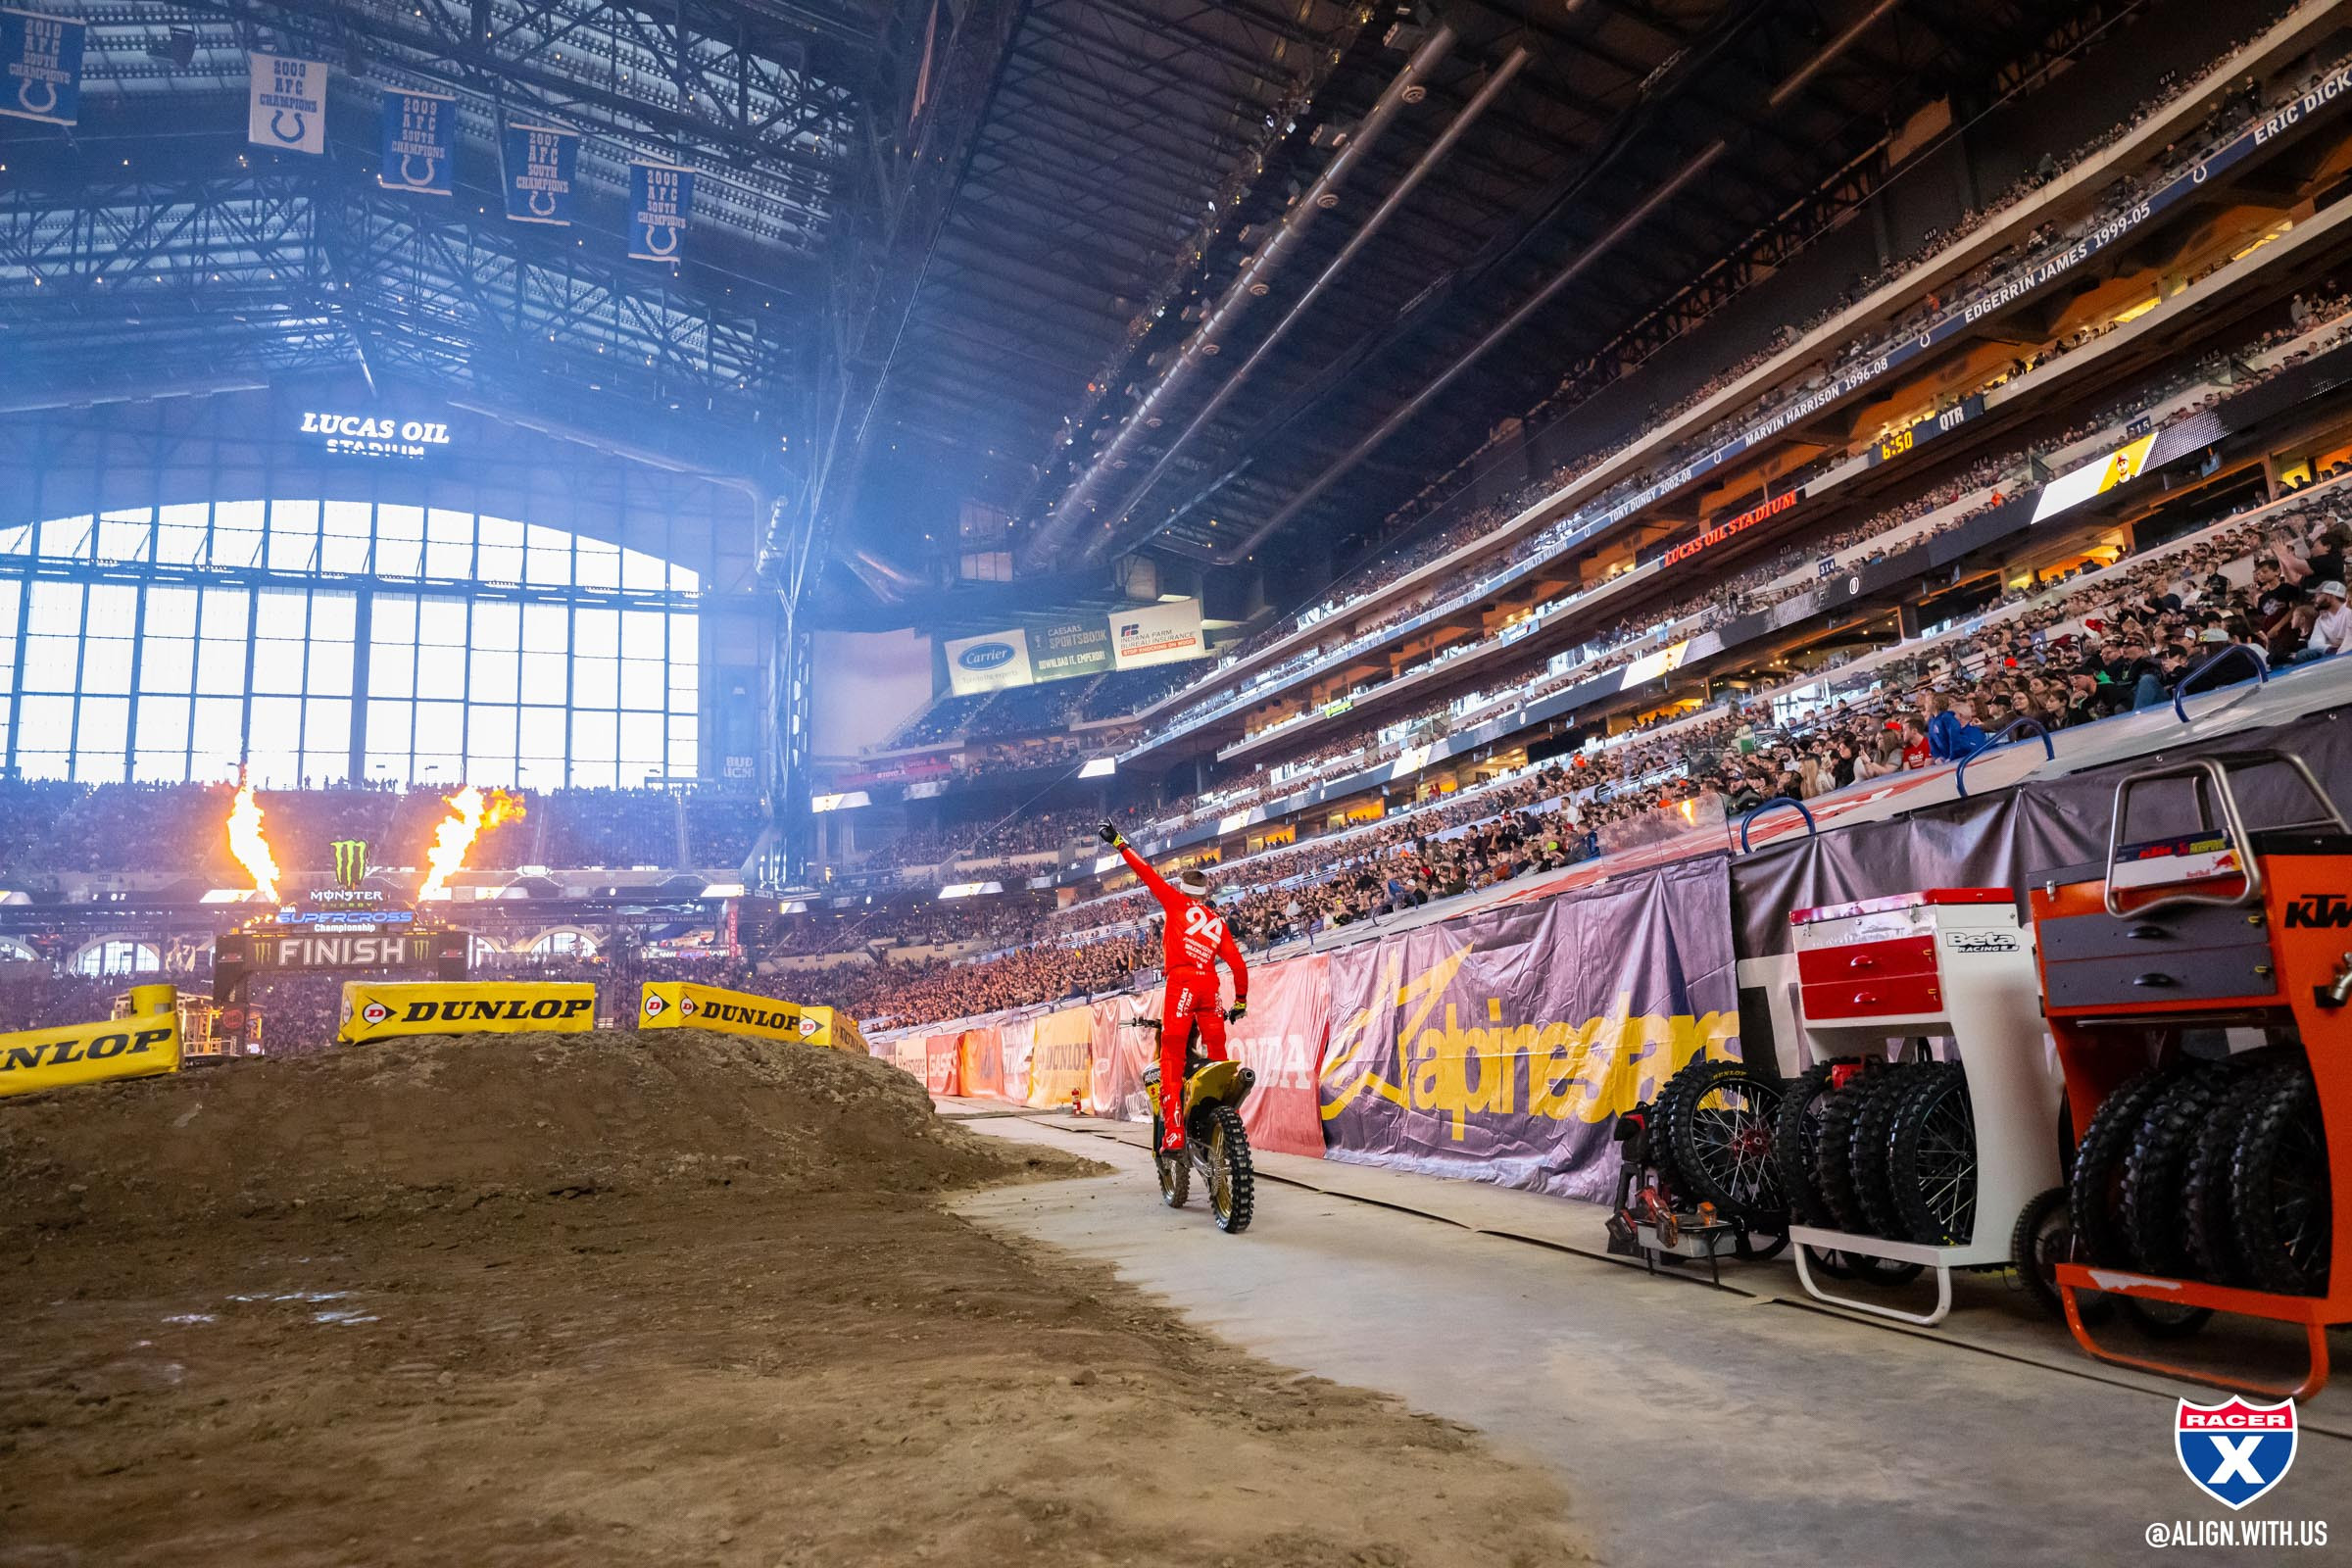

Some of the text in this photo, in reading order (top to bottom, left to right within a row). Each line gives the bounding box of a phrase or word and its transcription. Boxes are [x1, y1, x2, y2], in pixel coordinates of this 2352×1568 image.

[24, 51, 58, 67] SOUTH
[9, 63, 71, 85] CHAMPIONS
[260, 93, 317, 113] CHAMPIONS
[2254, 106, 2299, 146] ERIC
[403, 129, 434, 144] SOUTH
[529, 132, 560, 146] 2007
[392, 140, 445, 159] CHAMPIONS
[528, 145, 558, 165] AFC
[528, 164, 558, 178] SOUTH
[515, 175, 568, 193] CHAMPIONS
[648, 186, 677, 202] AFC
[648, 201, 676, 213] SOUTH
[638, 212, 686, 228] CHAMPIONS
[1965, 202, 2150, 323] EDGERRIN JAMES 1999-05
[1745, 358, 1888, 447] MARVIN HARRISON 1996-08
[300, 412, 451, 444] LUCAS OIL
[1882, 406, 1964, 460] 6:50 QTR
[2130, 419, 2150, 434] 15
[326, 438, 424, 460] STADIUM
[1608, 469, 1691, 523] TONY DUNGY 2002-08
[1664, 490, 1796, 567] LUCAS OIL STADIUM
[1523, 540, 1567, 571] COLTS NATION
[1820, 562, 1835, 574] 314
[1048, 624, 1082, 637] CAESARS
[1050, 629, 1107, 649] SPORTSBOOK
[1121, 634, 1151, 644] INDIANA
[1121, 631, 1194, 650] BUREAU INSURANCE
[1139, 643, 1167, 654] KNOCKING
[966, 648, 1007, 665] Carrier
[1039, 657, 1069, 670] DOWNLOAD
[726, 756, 753, 766] BUD
[310, 889, 383, 903] MONSTER
[275, 911, 415, 923] SUPERCROSS
[2284, 894, 2352, 928] KTM
[314, 923, 376, 933] Championship
[1184, 906, 1223, 945] 94
[1946, 932, 2016, 948] Beta
[1958, 945, 1999, 954] RACING
[277, 938, 407, 966] FINISH
[1185, 943, 1211, 960] SUZUKI
[400, 1000, 592, 1023] DUNLOP
[1176, 987, 1189, 1018] SUZUKI
[701, 1002, 800, 1031] DUNLOP
[0, 1028, 172, 1071] NLOP
[1046, 1043, 1090, 1070] DUNLOP
[1227, 1033, 1311, 1091] ONDA
[1414, 991, 1743, 1142] alpinestars
